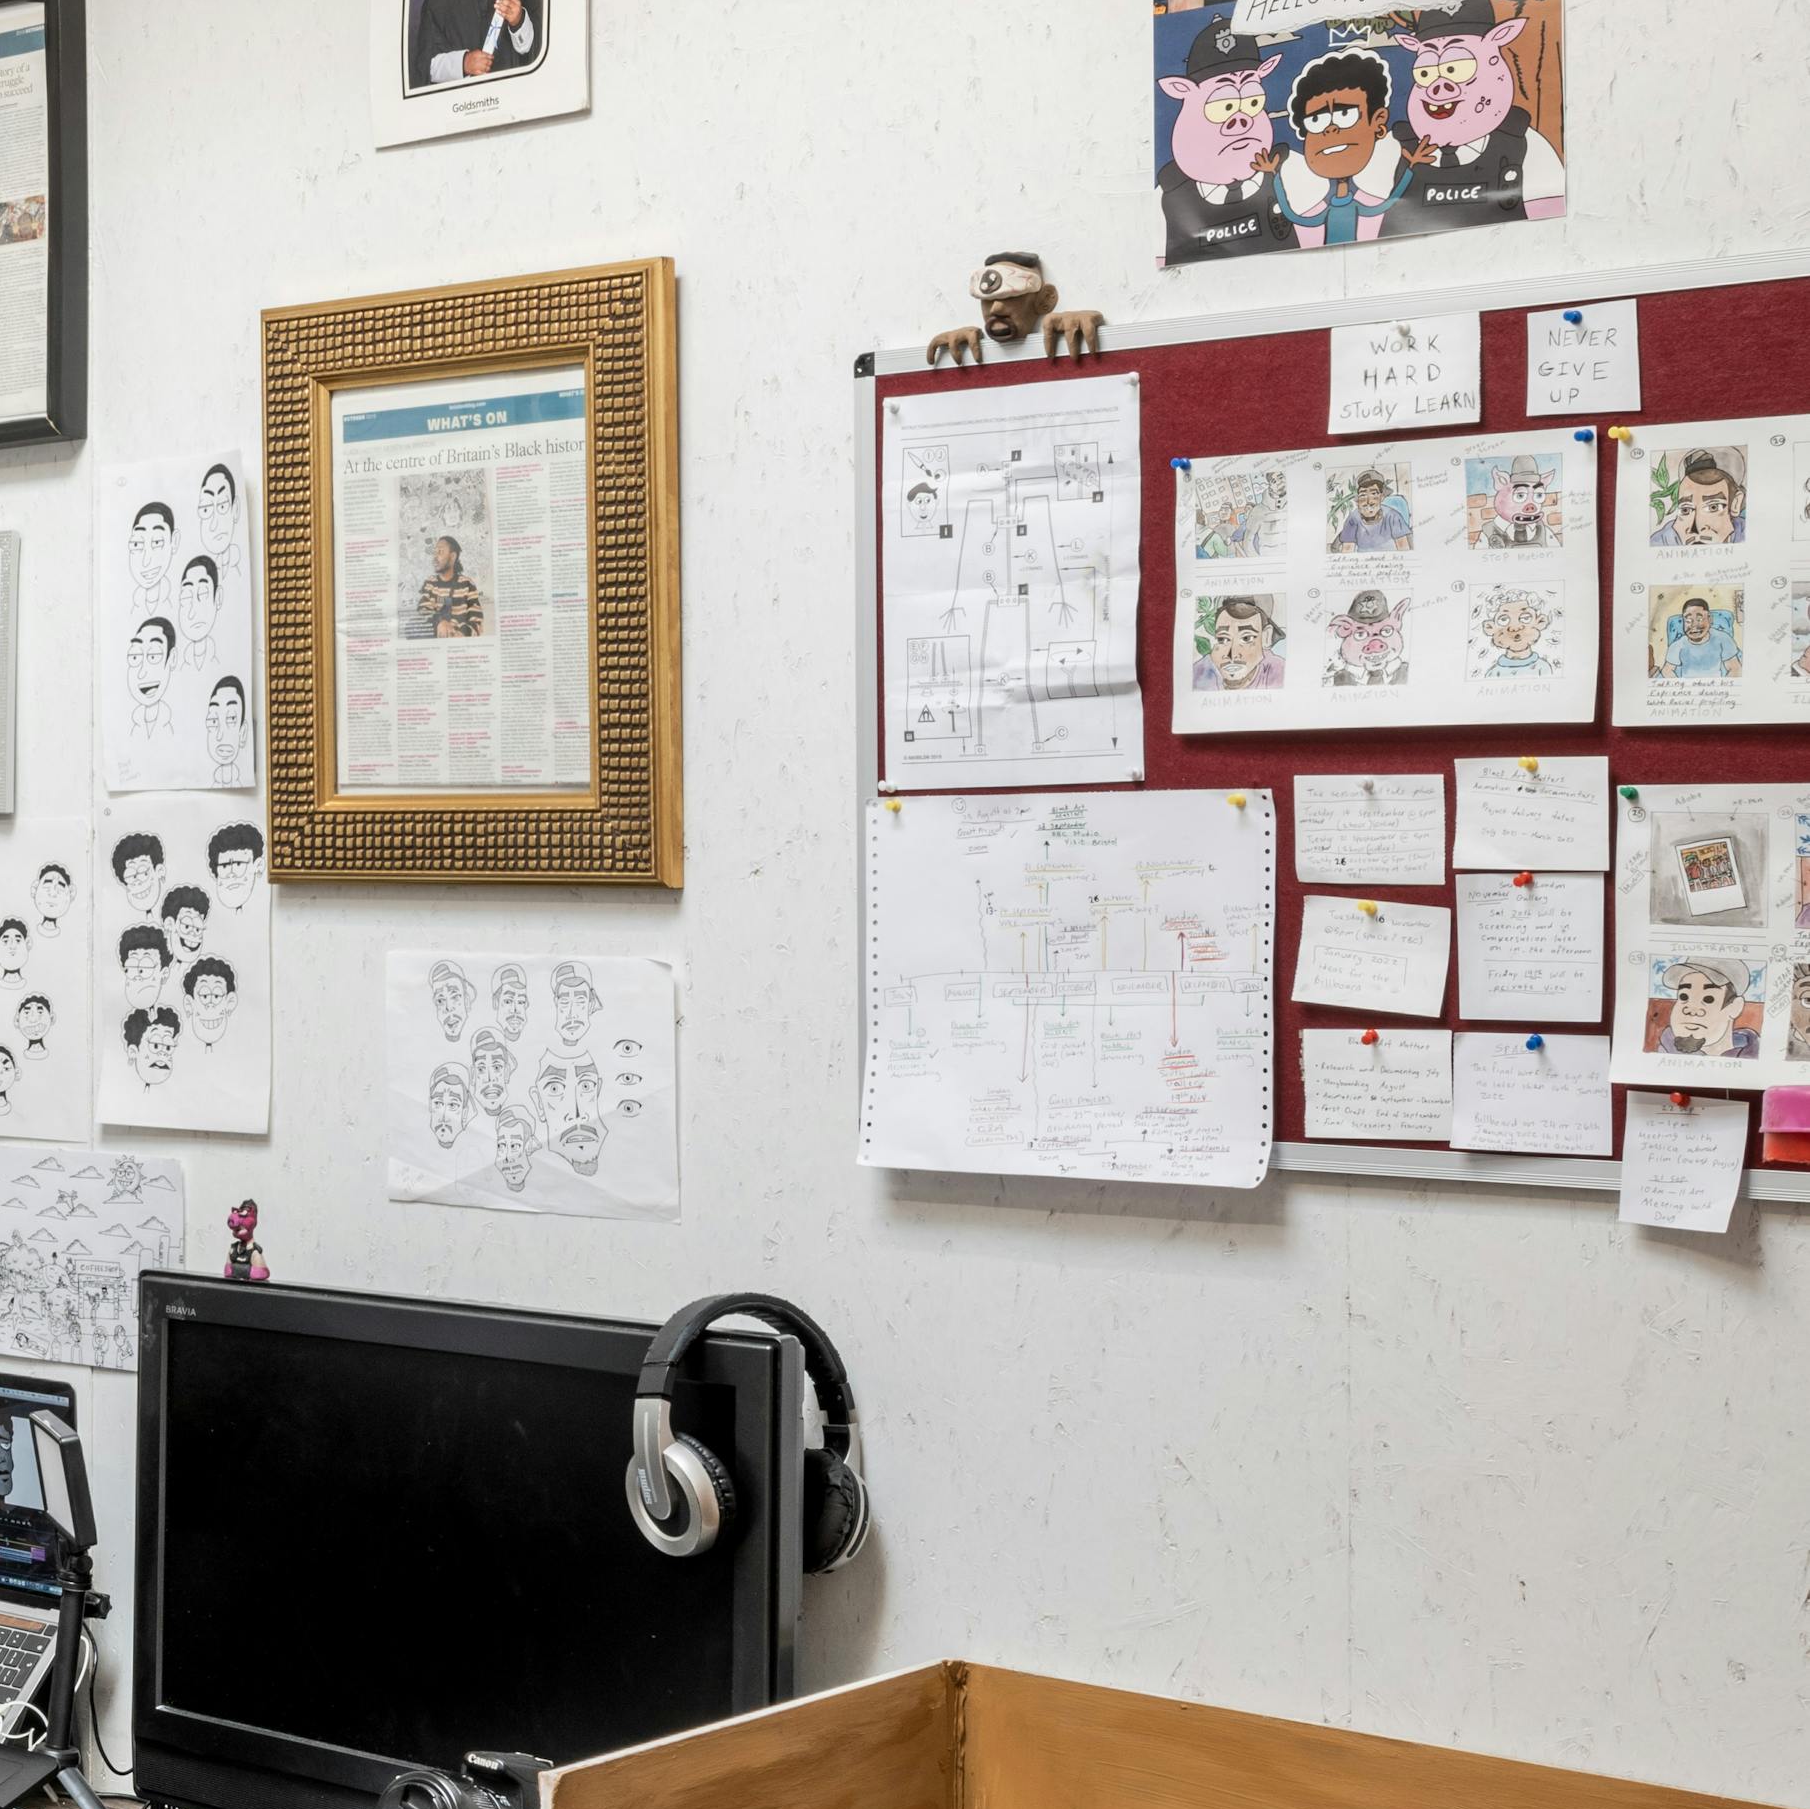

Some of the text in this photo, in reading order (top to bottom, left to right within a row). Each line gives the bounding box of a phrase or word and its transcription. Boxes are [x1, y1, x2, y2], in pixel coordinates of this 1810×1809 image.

[452, 96, 500, 113] Goldsmiths
[1425, 184, 1482, 204] POLICE
[1205, 219, 1258, 243] POLICE
[1370, 334, 1441, 355] WORK
[1548, 327, 1618, 347] NEVER
[1363, 363, 1441, 392] HARD
[1538, 361, 1610, 381] GIVE
[1414, 391, 1477, 415] LEARN
[1549, 388, 1580, 403] UP
[427, 410, 508, 432] WHAT'S ON
[343, 459, 361, 475] At
[363, 457, 382, 472] the
[386, 455, 426, 470] centre
[429, 451, 443, 465] of
[447, 444, 501, 464] Britain's
[505, 441, 542, 459] Black
[1656, 546, 1735, 560] ANIMATION
[1649, 707, 1723, 718] ANIMATION
[1657, 1056, 1743, 1069] ANIMATION
[165, 1304, 197, 1317] BRAVIA
[467, 1752, 500, 1771] Canon
